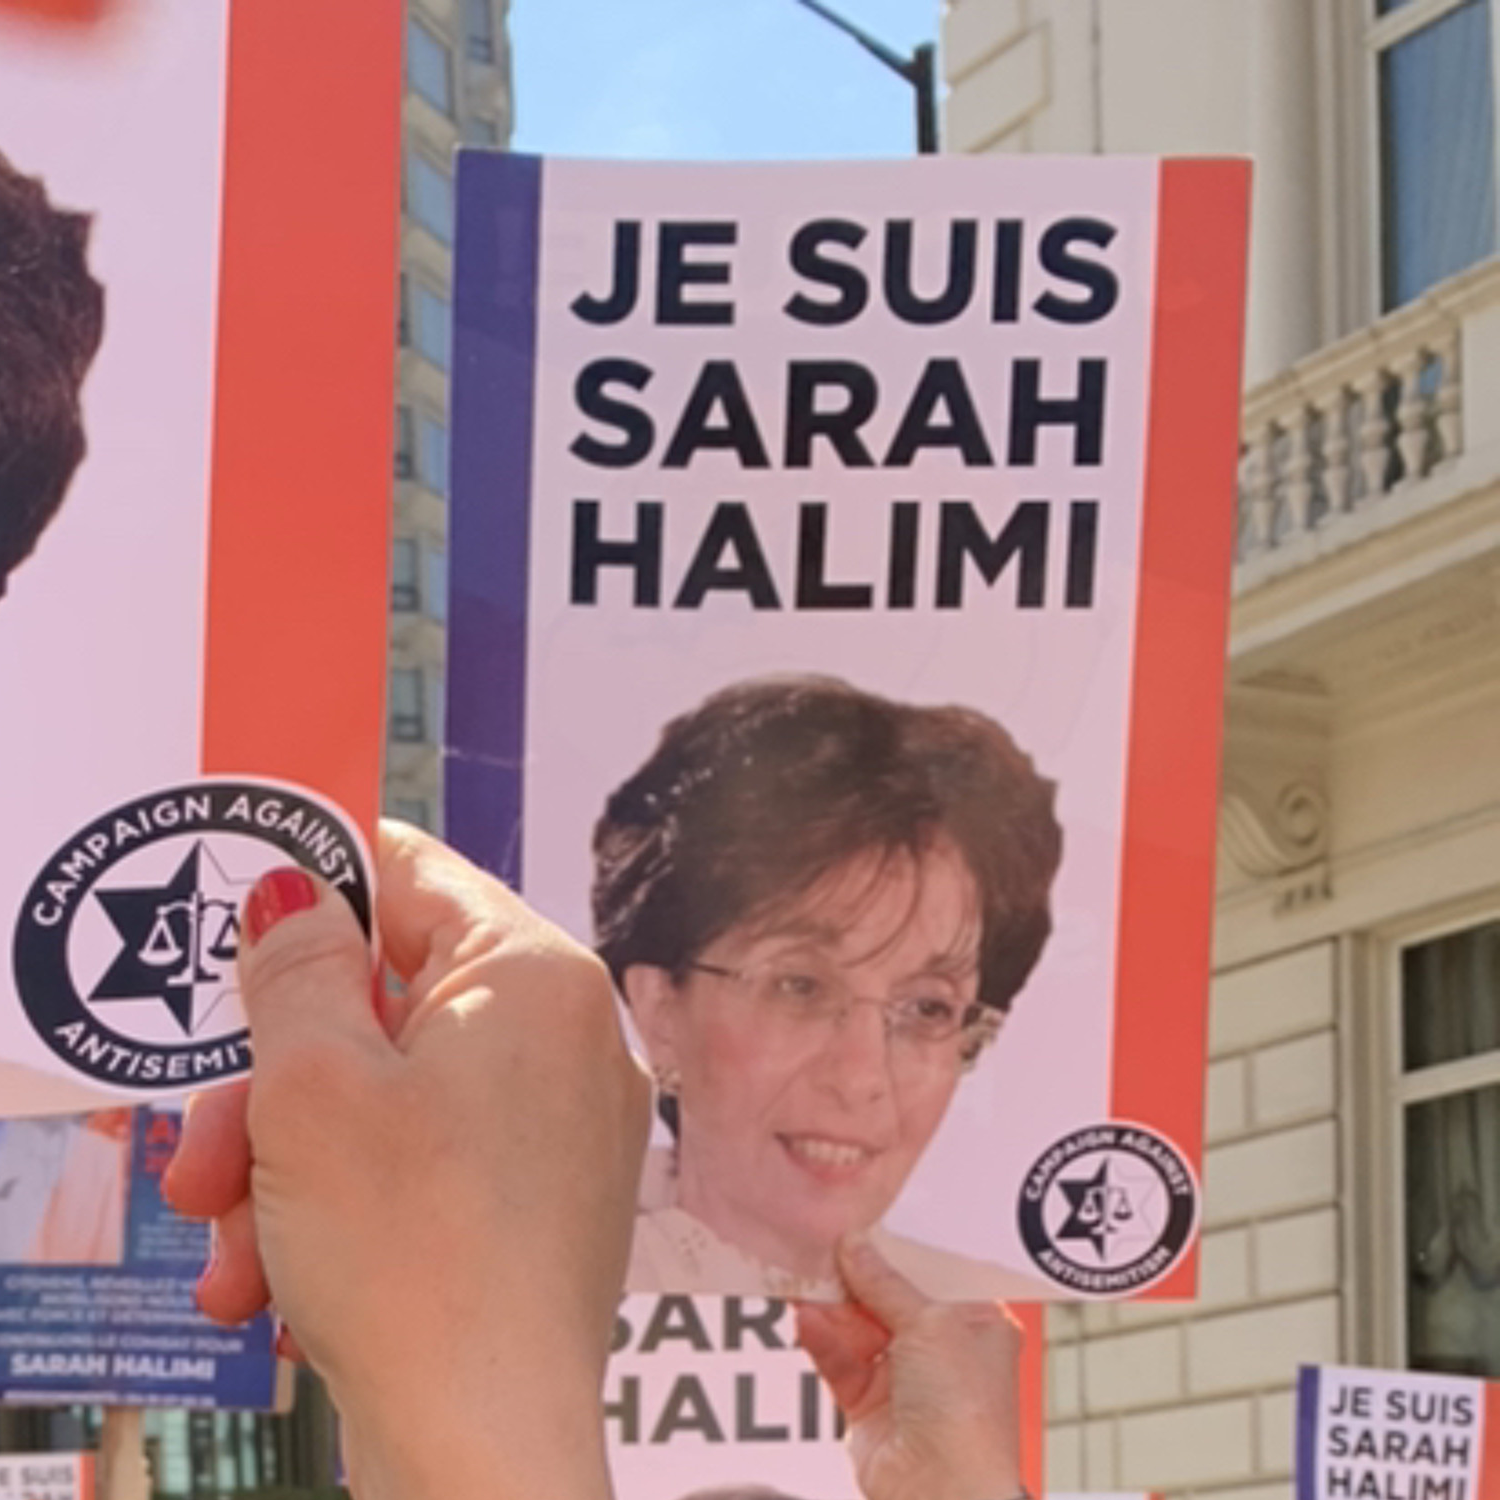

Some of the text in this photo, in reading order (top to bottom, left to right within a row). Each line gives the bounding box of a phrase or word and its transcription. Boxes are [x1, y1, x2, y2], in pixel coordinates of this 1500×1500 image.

[571, 217, 1120, 326] JE SUIS
[569, 357, 1108, 469] SARAH
[569, 499, 1100, 611] HALIMI
[33, 795, 358, 927] CAMPAIGN AGAINST
[55, 1021, 252, 1079] ANTISEMI
[1025, 1131, 1116, 1201] CAMPAIGN
[10, 1353, 216, 1380] SARAH HALIMI
[603, 1373, 846, 1445] HALI
[1329, 1386, 1475, 1427] JE SUIS
[1327, 1425, 1470, 1468] SARAH
